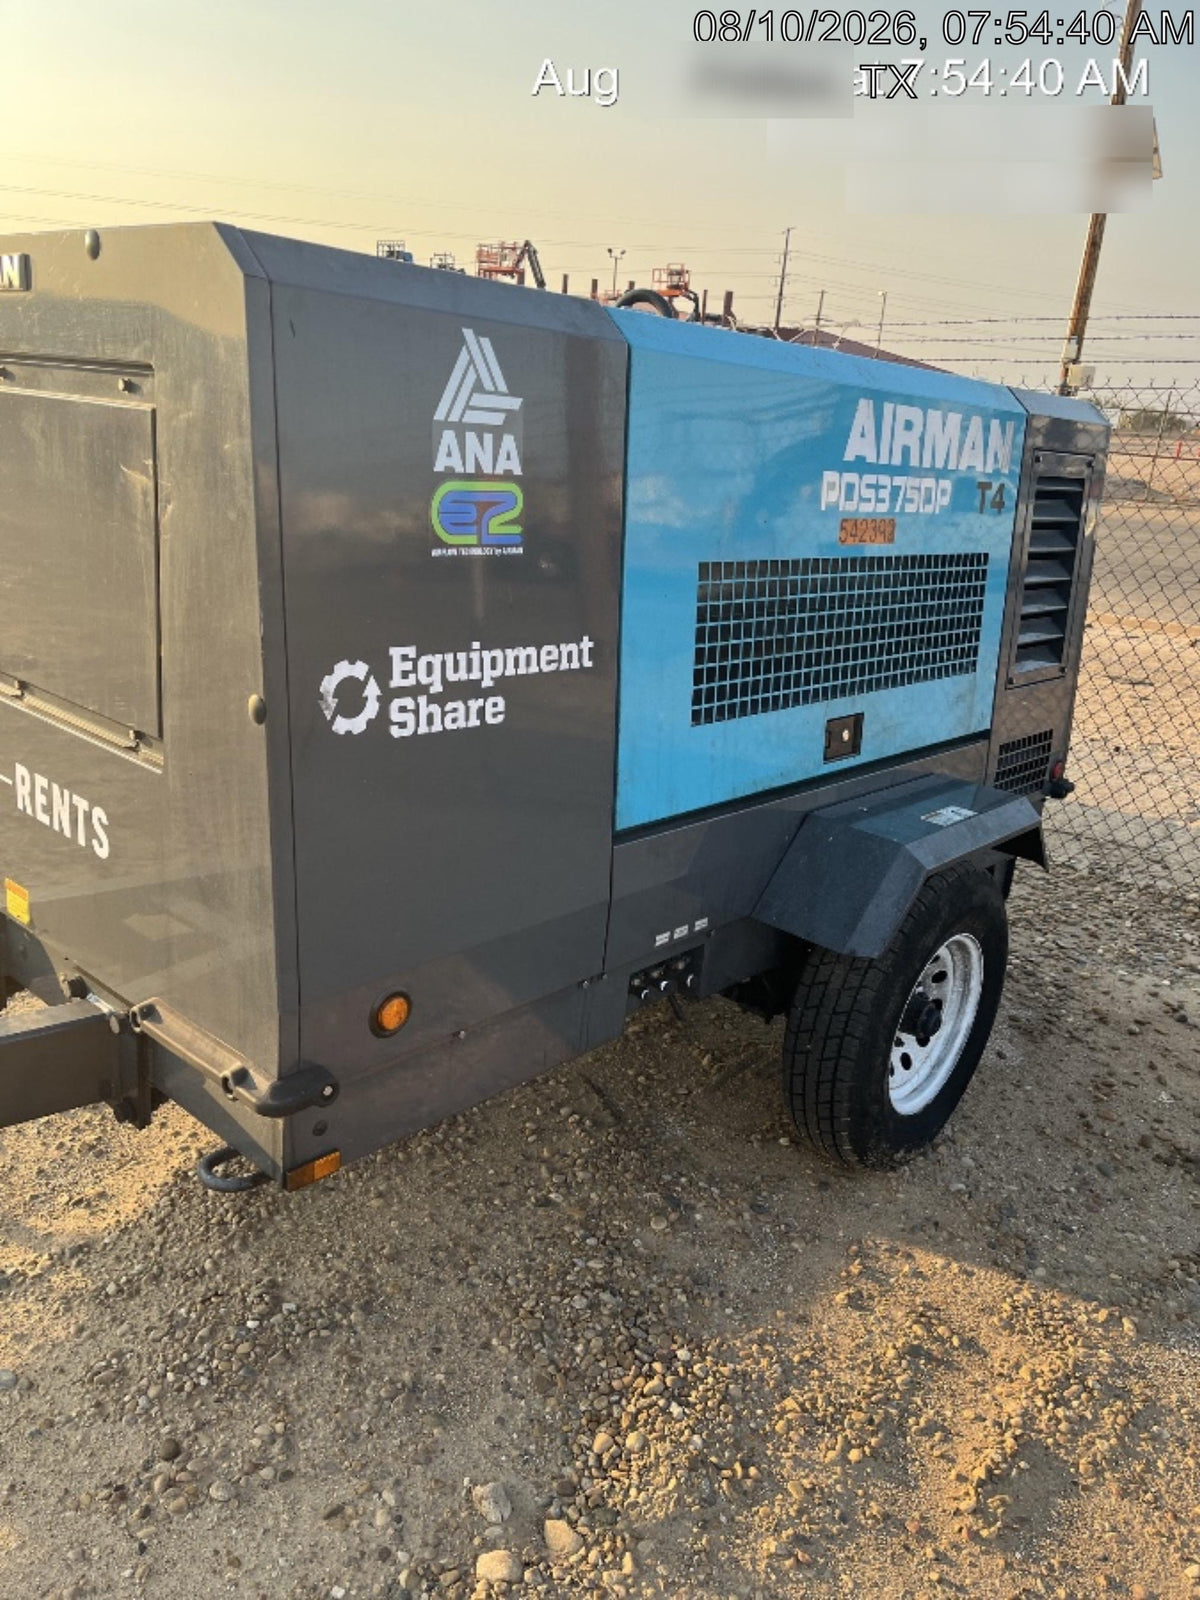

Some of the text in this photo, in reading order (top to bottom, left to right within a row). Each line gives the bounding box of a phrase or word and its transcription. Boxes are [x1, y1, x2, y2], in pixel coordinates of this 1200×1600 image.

[433, 429, 523, 475] ANA
[843, 398, 1015, 473] AIRMAN
[977, 481, 1006, 514] T4
[389, 635, 594, 693] Equipment
[389, 695, 506, 739] Share
